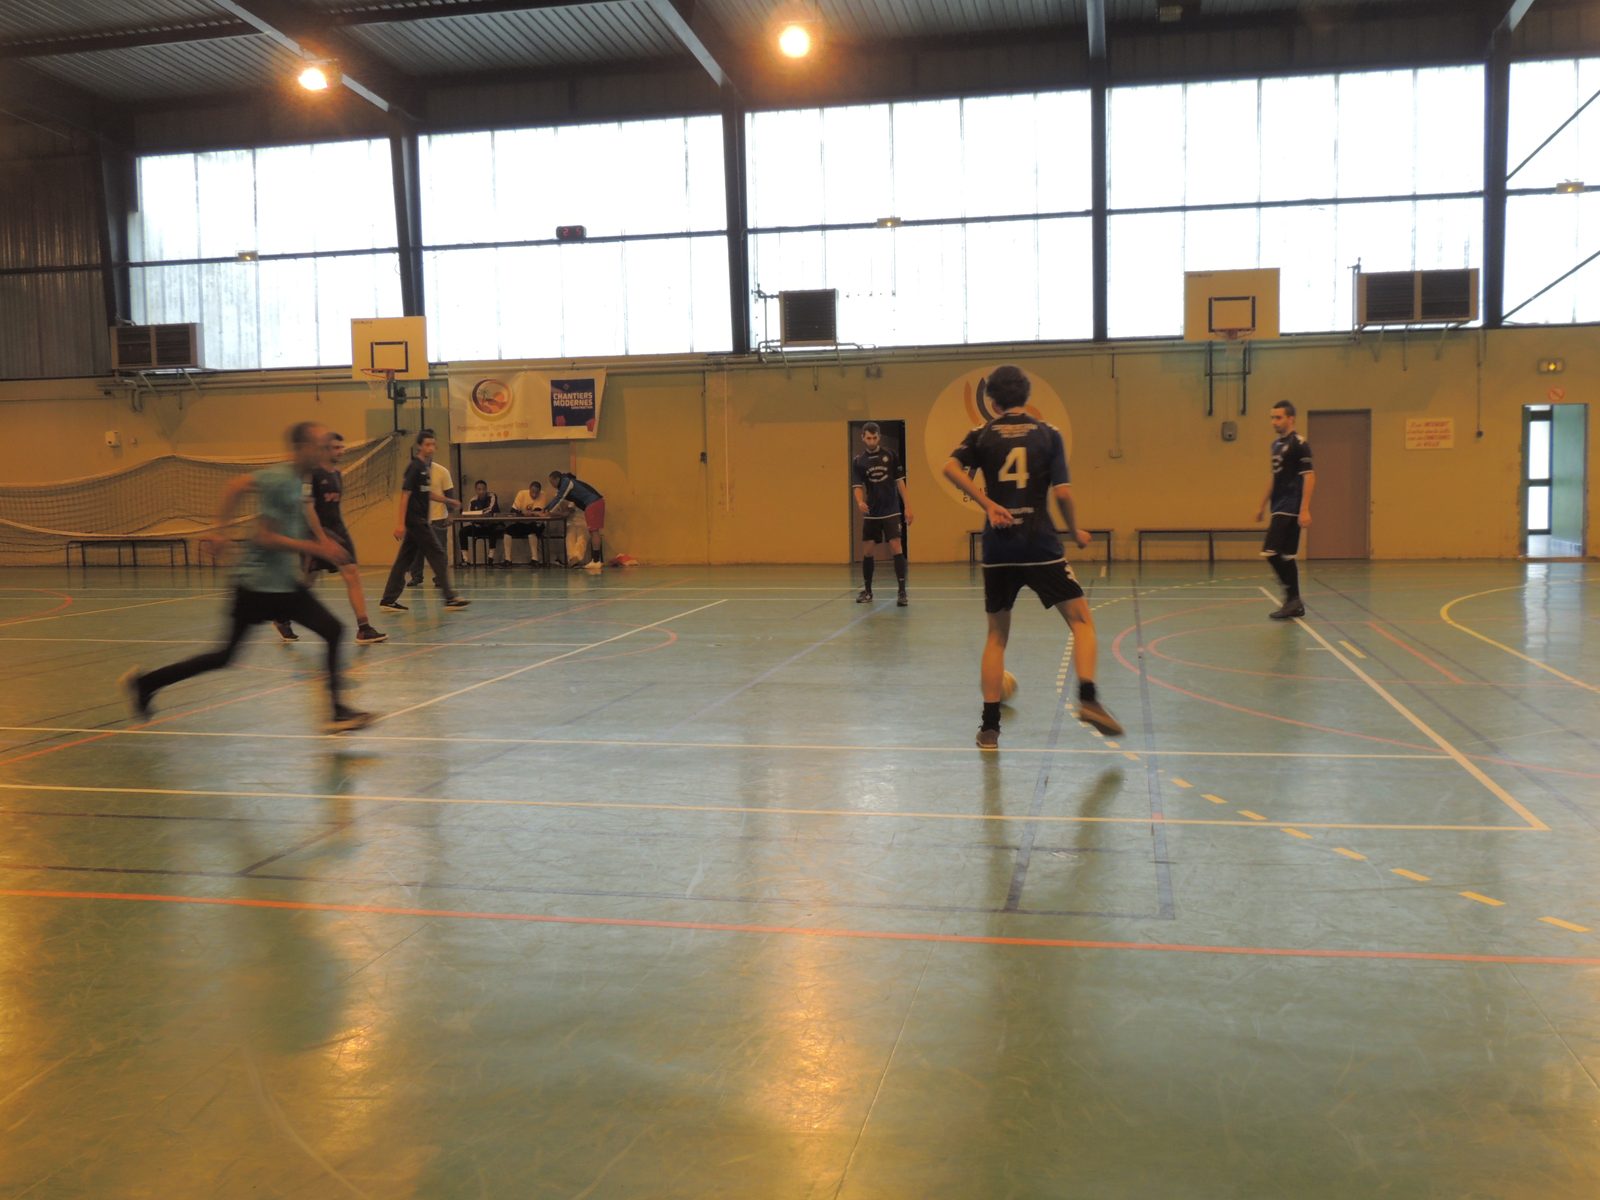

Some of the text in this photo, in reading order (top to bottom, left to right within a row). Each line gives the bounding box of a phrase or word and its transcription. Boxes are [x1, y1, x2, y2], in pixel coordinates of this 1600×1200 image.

[553, 391, 593, 400] CHANTIERS
[553, 399, 593, 407] MODERNES
[998, 447, 1030, 489] 4
